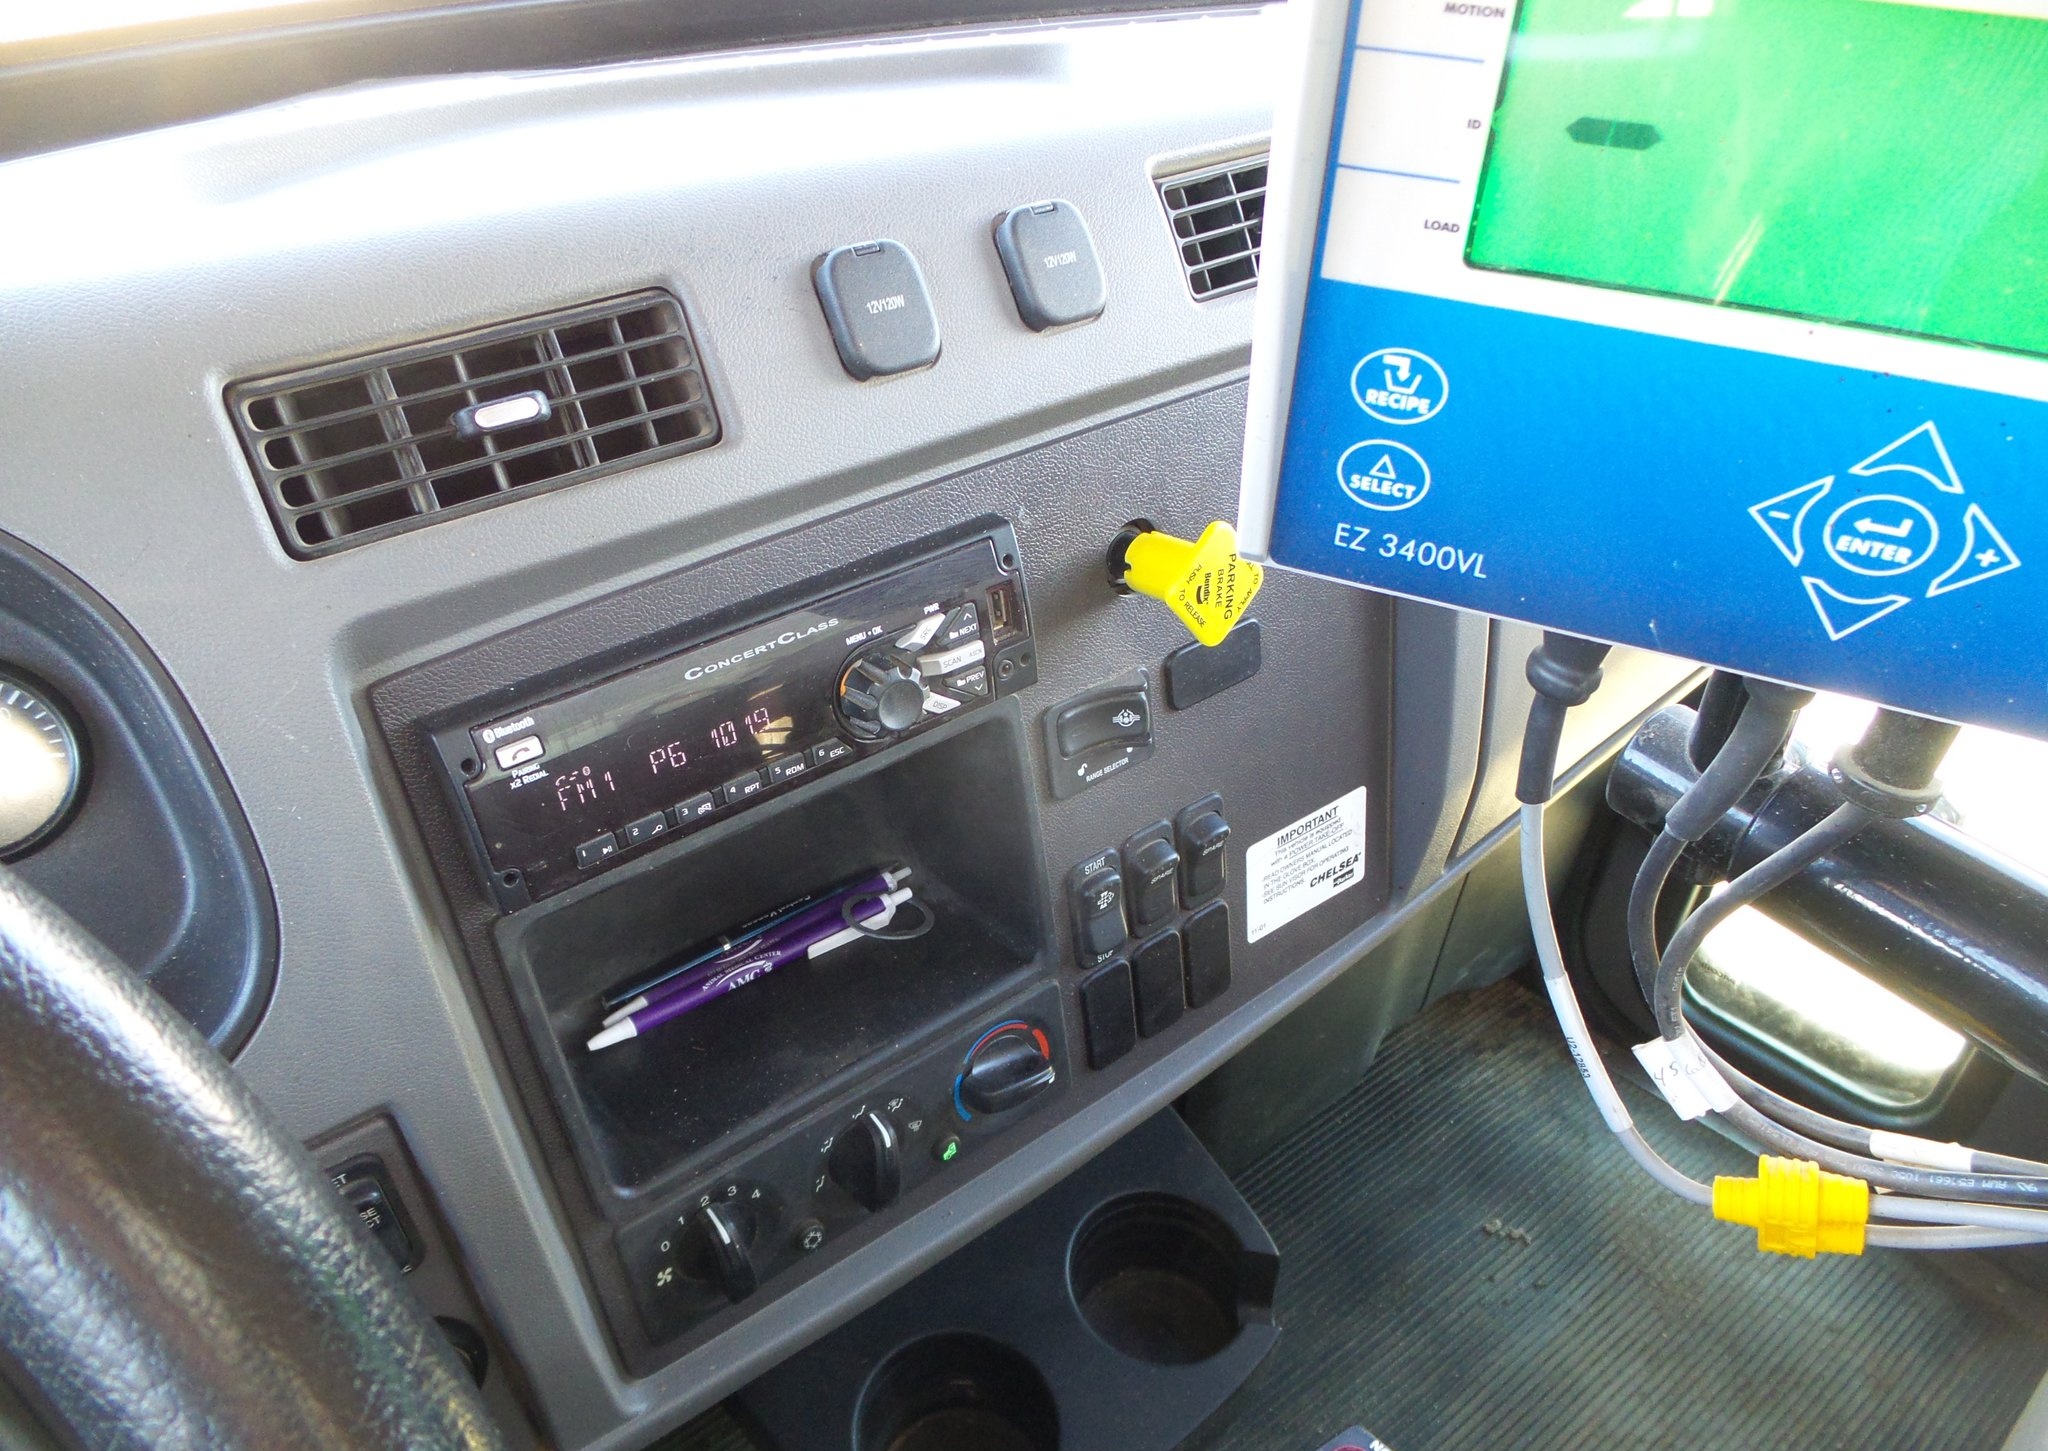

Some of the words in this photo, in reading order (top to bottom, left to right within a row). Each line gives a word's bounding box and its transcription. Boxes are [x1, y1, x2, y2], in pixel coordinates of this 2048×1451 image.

[1444, 2, 1505, 18] MOTION
[1466, 118, 1482, 130] ID
[1424, 219, 1460, 233] LOAD
[1043, 250, 1077, 269] 12V120W
[866, 294, 905, 315] 12V120W
[1364, 388, 1431, 415] RECIPE
[1349, 473, 1416, 500] SELECT
[1333, 522, 1370, 552] EZ
[1378, 532, 1487, 579] 3400VL
[1835, 534, 1913, 565] ENTER
[1224, 553, 1237, 620] PARKING
[1252, 573, 1260, 585] TO
[1203, 572, 1212, 605] Bendix
[1215, 568, 1225, 608] BRAKE
[923, 602, 940, 615] PWR
[1178, 588, 1186, 601] TO
[1184, 601, 1207, 628] RELEASE
[845, 632, 867, 646] MENU
[872, 625, 883, 636] OK
[920, 625, 933, 641] SRC
[959, 622, 977, 636] NEXT
[942, 655, 962, 669] SCAN
[966, 670, 985, 684] PREV
[932, 699, 948, 709] DISP
[493, 716, 535, 739] Bluetooth
[818, 749, 825, 757] 6
[829, 746, 845, 758] ESC
[775, 766, 781, 774] 5
[785, 762, 805, 776] RDM
[1086, 768, 1103, 783] RANGE
[1103, 757, 1129, 774] SELECTOR
[730, 786, 736, 794] 4
[744, 781, 760, 794] RPT
[681, 808, 688, 816] 3
[632, 828, 639, 836] 2
[1277, 806, 1339, 846] IMPORTANT
[1280, 857, 1305, 873] OWNERS
[1306, 845, 1328, 859] MANUAL
[1329, 830, 1353, 848] LOCATED
[1289, 840, 1313, 857] POWER
[1084, 856, 1106, 875] START
[1310, 854, 1359, 887] CHELSEA
[702, 973, 724, 992] ANIMAL
[728, 969, 761, 991] AMC
[727, 1185, 737, 1197] 3
[751, 1188, 761, 1199] 4
[700, 1195, 710, 1207] 2
[677, 1216, 685, 1225] 1
[660, 1241, 671, 1252] 0
